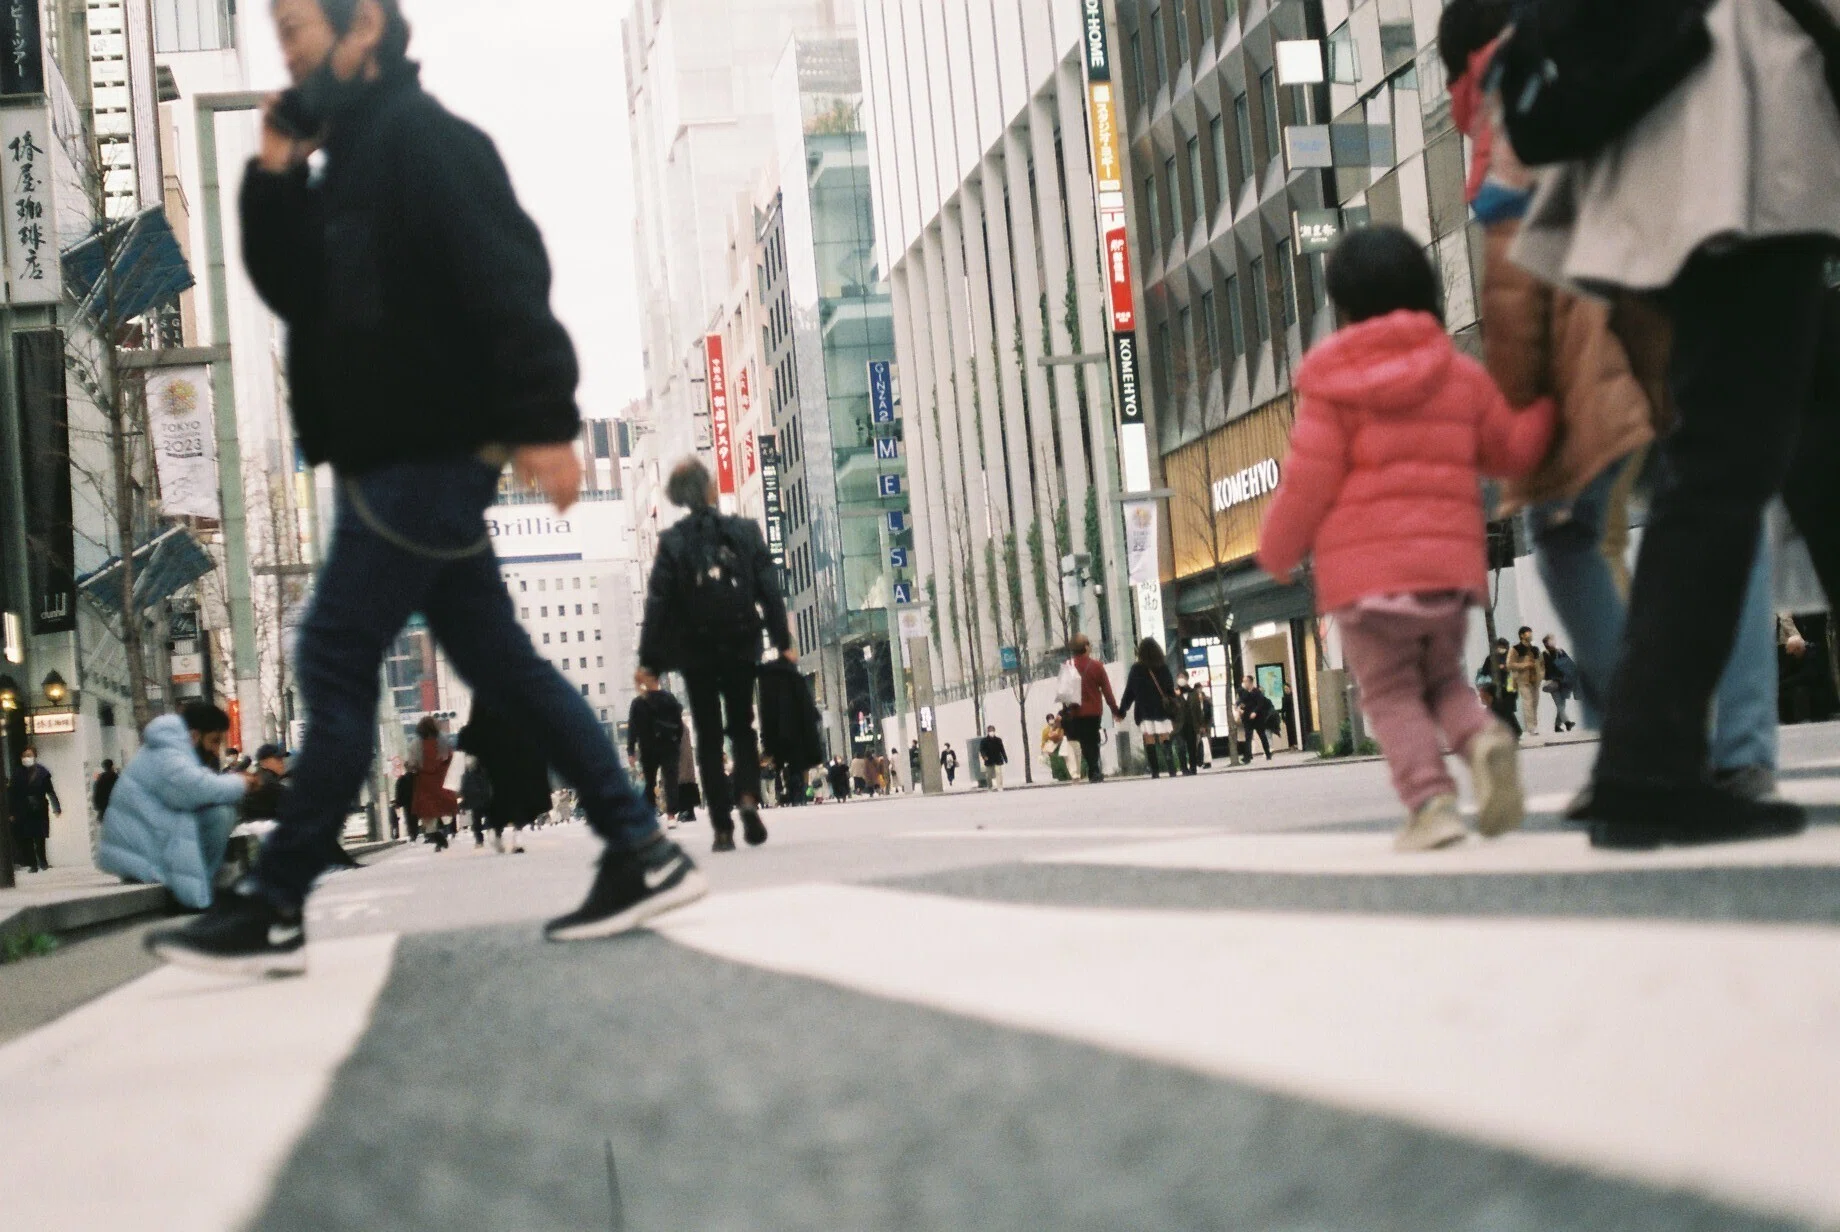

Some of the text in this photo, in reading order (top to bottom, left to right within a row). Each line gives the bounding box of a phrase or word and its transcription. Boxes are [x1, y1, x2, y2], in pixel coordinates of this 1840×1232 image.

[8, 130, 46, 280] 椿屋珈琲店
[1119, 338, 1138, 416] KOMEHYO
[163, 438, 202, 453] 2023
[1212, 457, 1279, 512] KOMEHYO
[487, 517, 572, 538] Brillia
[879, 438, 908, 603] MELSA
